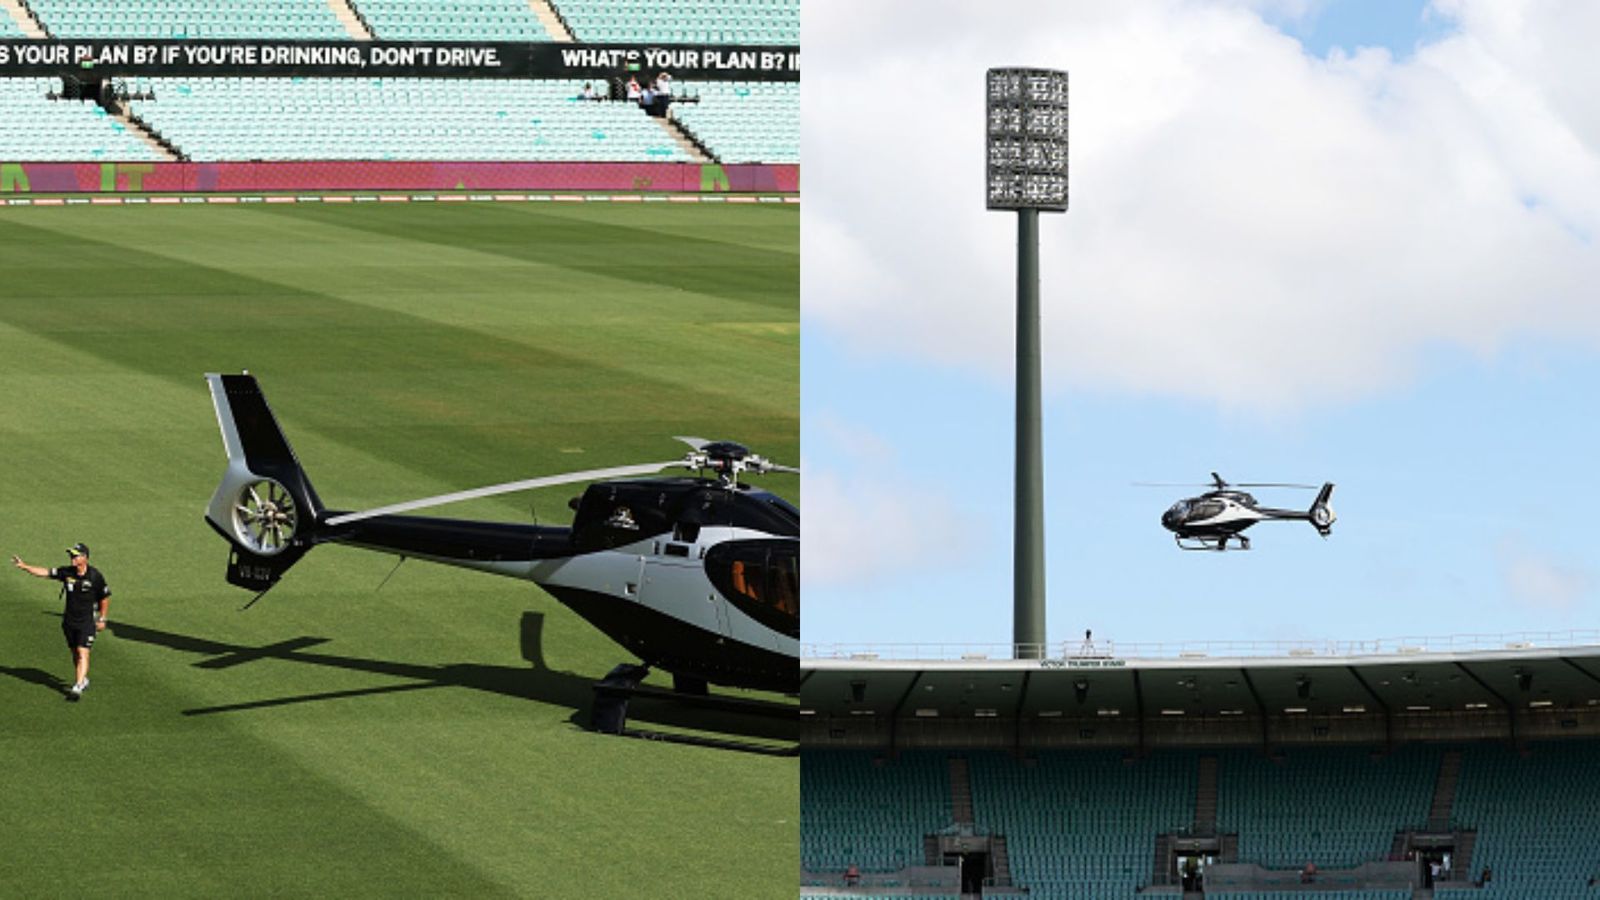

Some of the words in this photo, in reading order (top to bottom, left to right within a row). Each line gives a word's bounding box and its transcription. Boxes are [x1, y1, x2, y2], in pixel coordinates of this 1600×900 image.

[13, 45, 70, 64] YOUR
[75, 45, 128, 64] PLAN
[133, 45, 158, 64] B?
[161, 45, 180, 64] IF
[184, 45, 258, 64] YOU'RE
[261, 46, 367, 69] DRINKING,
[370, 47, 433, 66] DON'T
[436, 47, 501, 67] DRIVE.
[643, 49, 699, 68] YOUR
[702, 50, 757, 69] PLAN
[760, 51, 785, 70] B?
